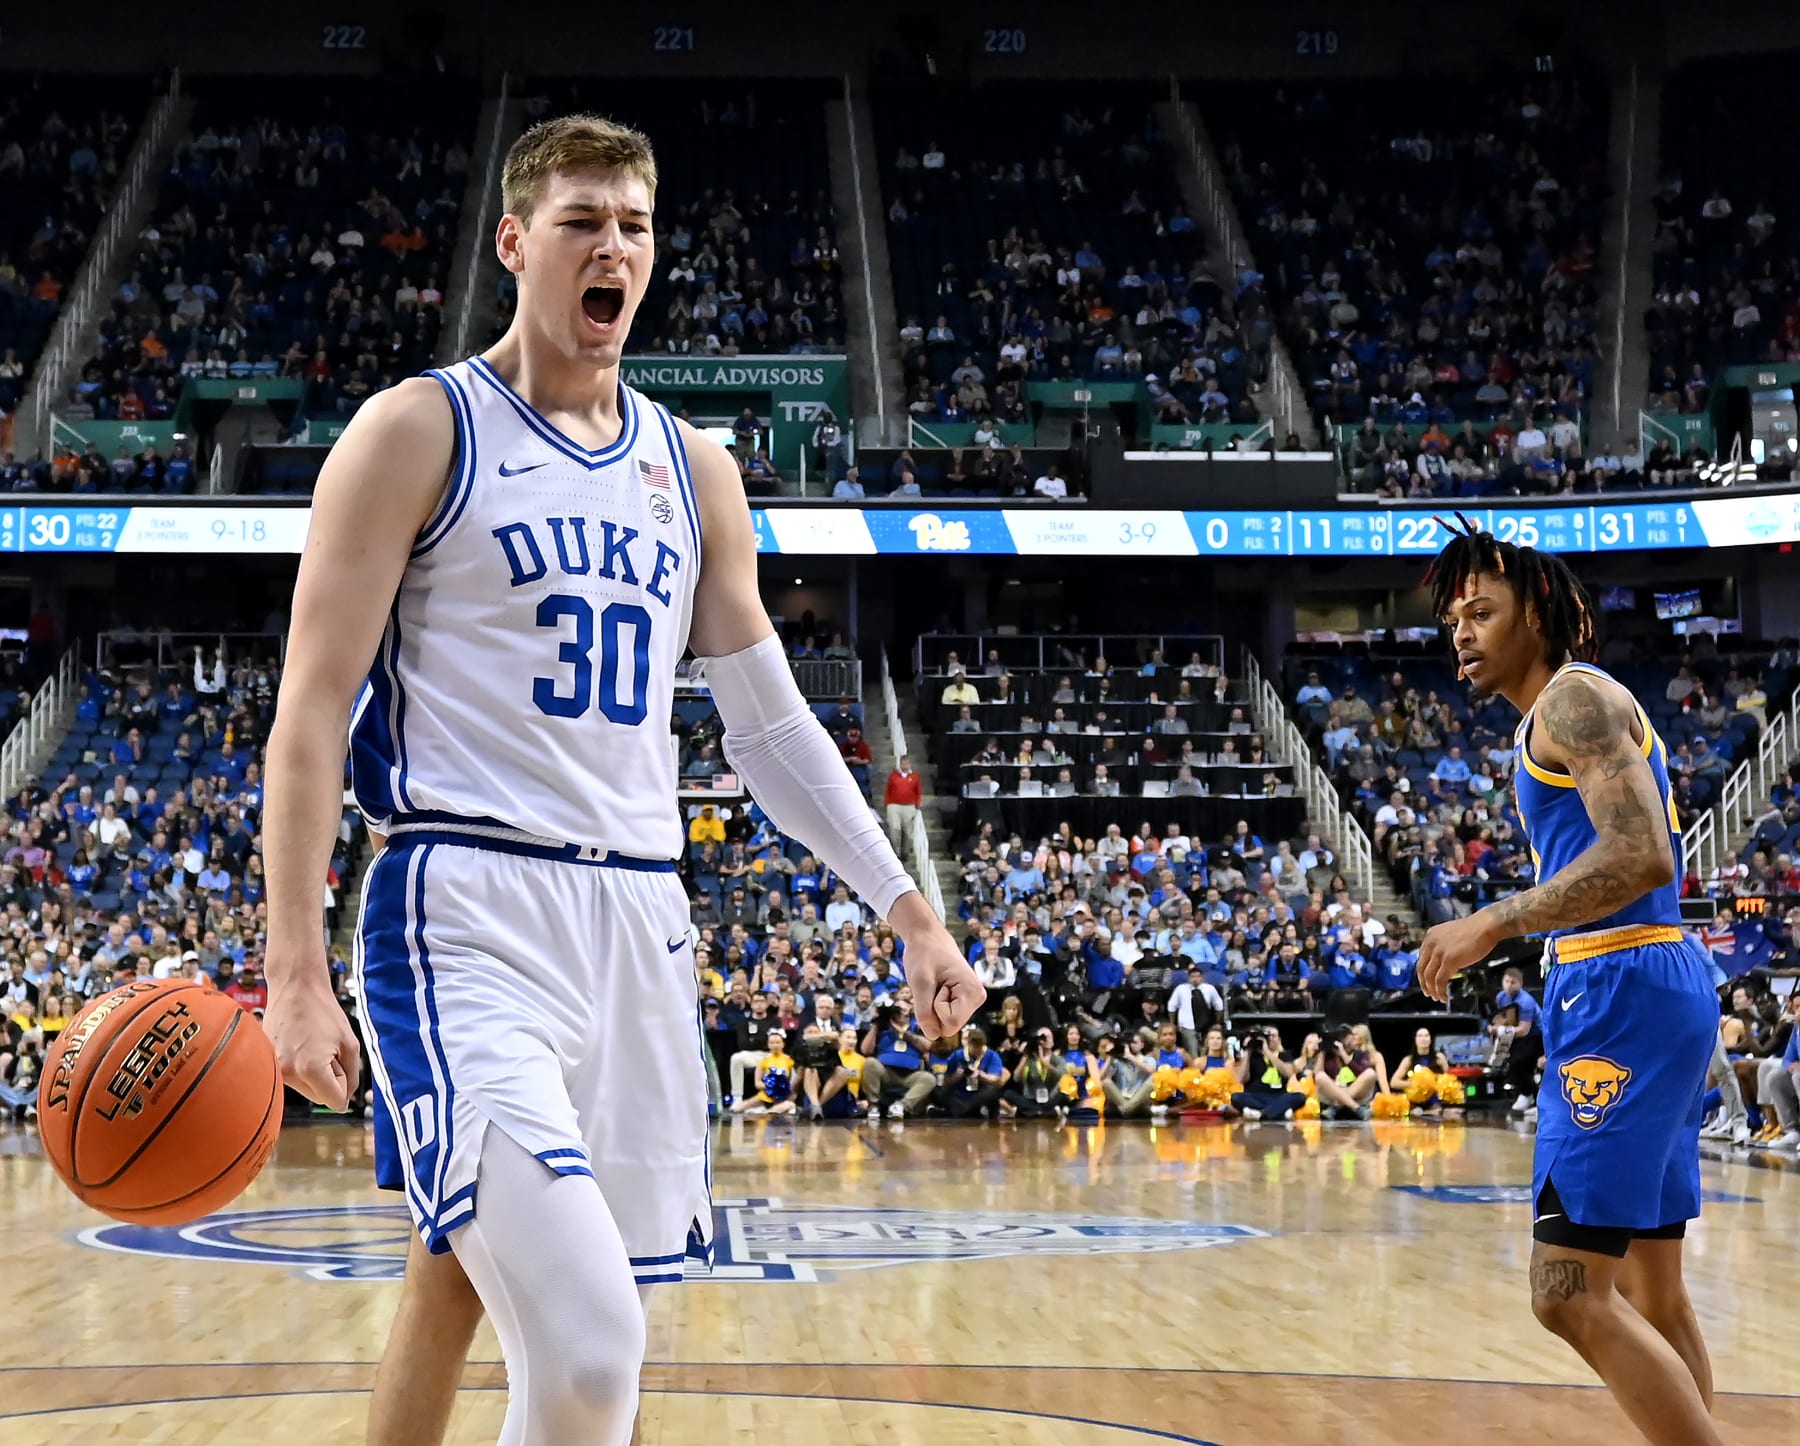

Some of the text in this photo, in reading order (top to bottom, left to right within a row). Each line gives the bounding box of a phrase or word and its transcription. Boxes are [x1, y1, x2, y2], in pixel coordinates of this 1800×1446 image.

[322, 25, 366, 49] 222
[654, 27, 694, 50] 221
[984, 29, 1026, 52] 220
[1296, 31, 1338, 55] 219
[619, 366, 824, 385] ANCIAL ADVISORS
[29, 514, 70, 546] 30
[97, 513, 118, 529] 22
[150, 519, 176, 528] TEAM
[210, 519, 266, 542] 9-18
[908, 513, 971, 551] Pitt
[1048, 522, 1074, 531] TEAM
[1243, 517, 1282, 532] PTS: 2
[1342, 517, 1387, 532] PTS: 10
[1499, 516, 1540, 548] 25
[1600, 513, 1635, 545] 31
[1, 532, 12, 548] 2
[101, 532, 112, 548] 2
[144, 532, 189, 540] POINTERS
[1044, 534, 1088, 543] POINTERS
[1118, 522, 1156, 544] 3-9
[1206, 518, 1228, 549] 0
[1244, 536, 1280, 550] FLS: 1
[1299, 518, 1331, 549] 11
[1343, 536, 1383, 551] FLS: 0
[1397, 518, 1438, 549] 22
[1576, 531, 1582, 547] 1
[1679, 527, 1685, 543] 1
[491, 517, 681, 608] DUKE
[532, 594, 652, 727] 30
[1735, 897, 1765, 913] PITT
[47, 981, 159, 1114] SPALDING
[140, 1021, 201, 1091] 1000
[95, 1000, 190, 1122] LEGACY
[400, 1093, 436, 1157] D
